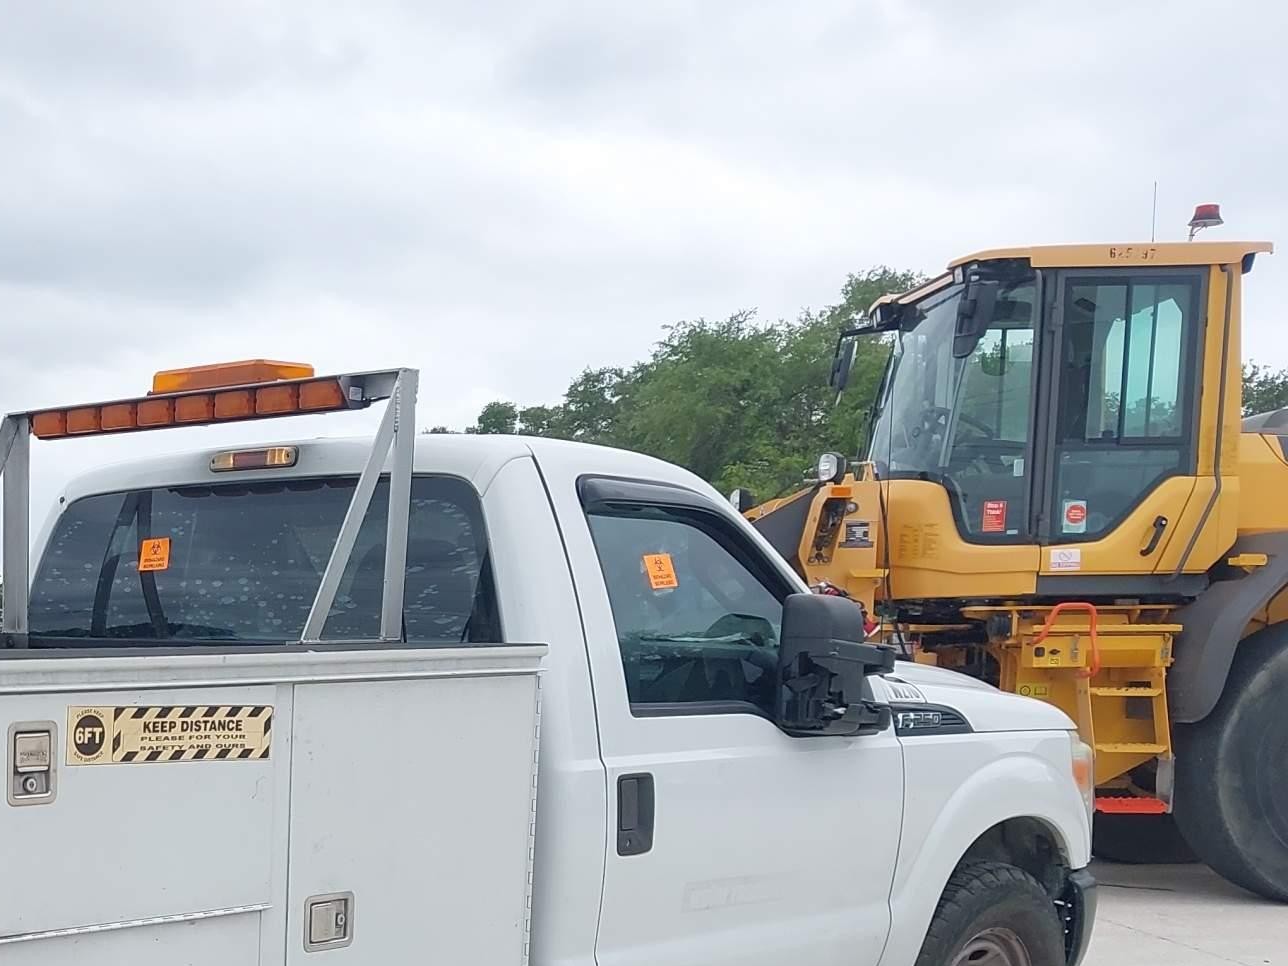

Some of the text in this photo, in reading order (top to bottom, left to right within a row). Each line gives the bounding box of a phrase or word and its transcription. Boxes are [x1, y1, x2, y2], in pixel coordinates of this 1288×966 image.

[143, 719, 243, 733] KEEP DISTANCE
[75, 727, 103, 744] 6FT
